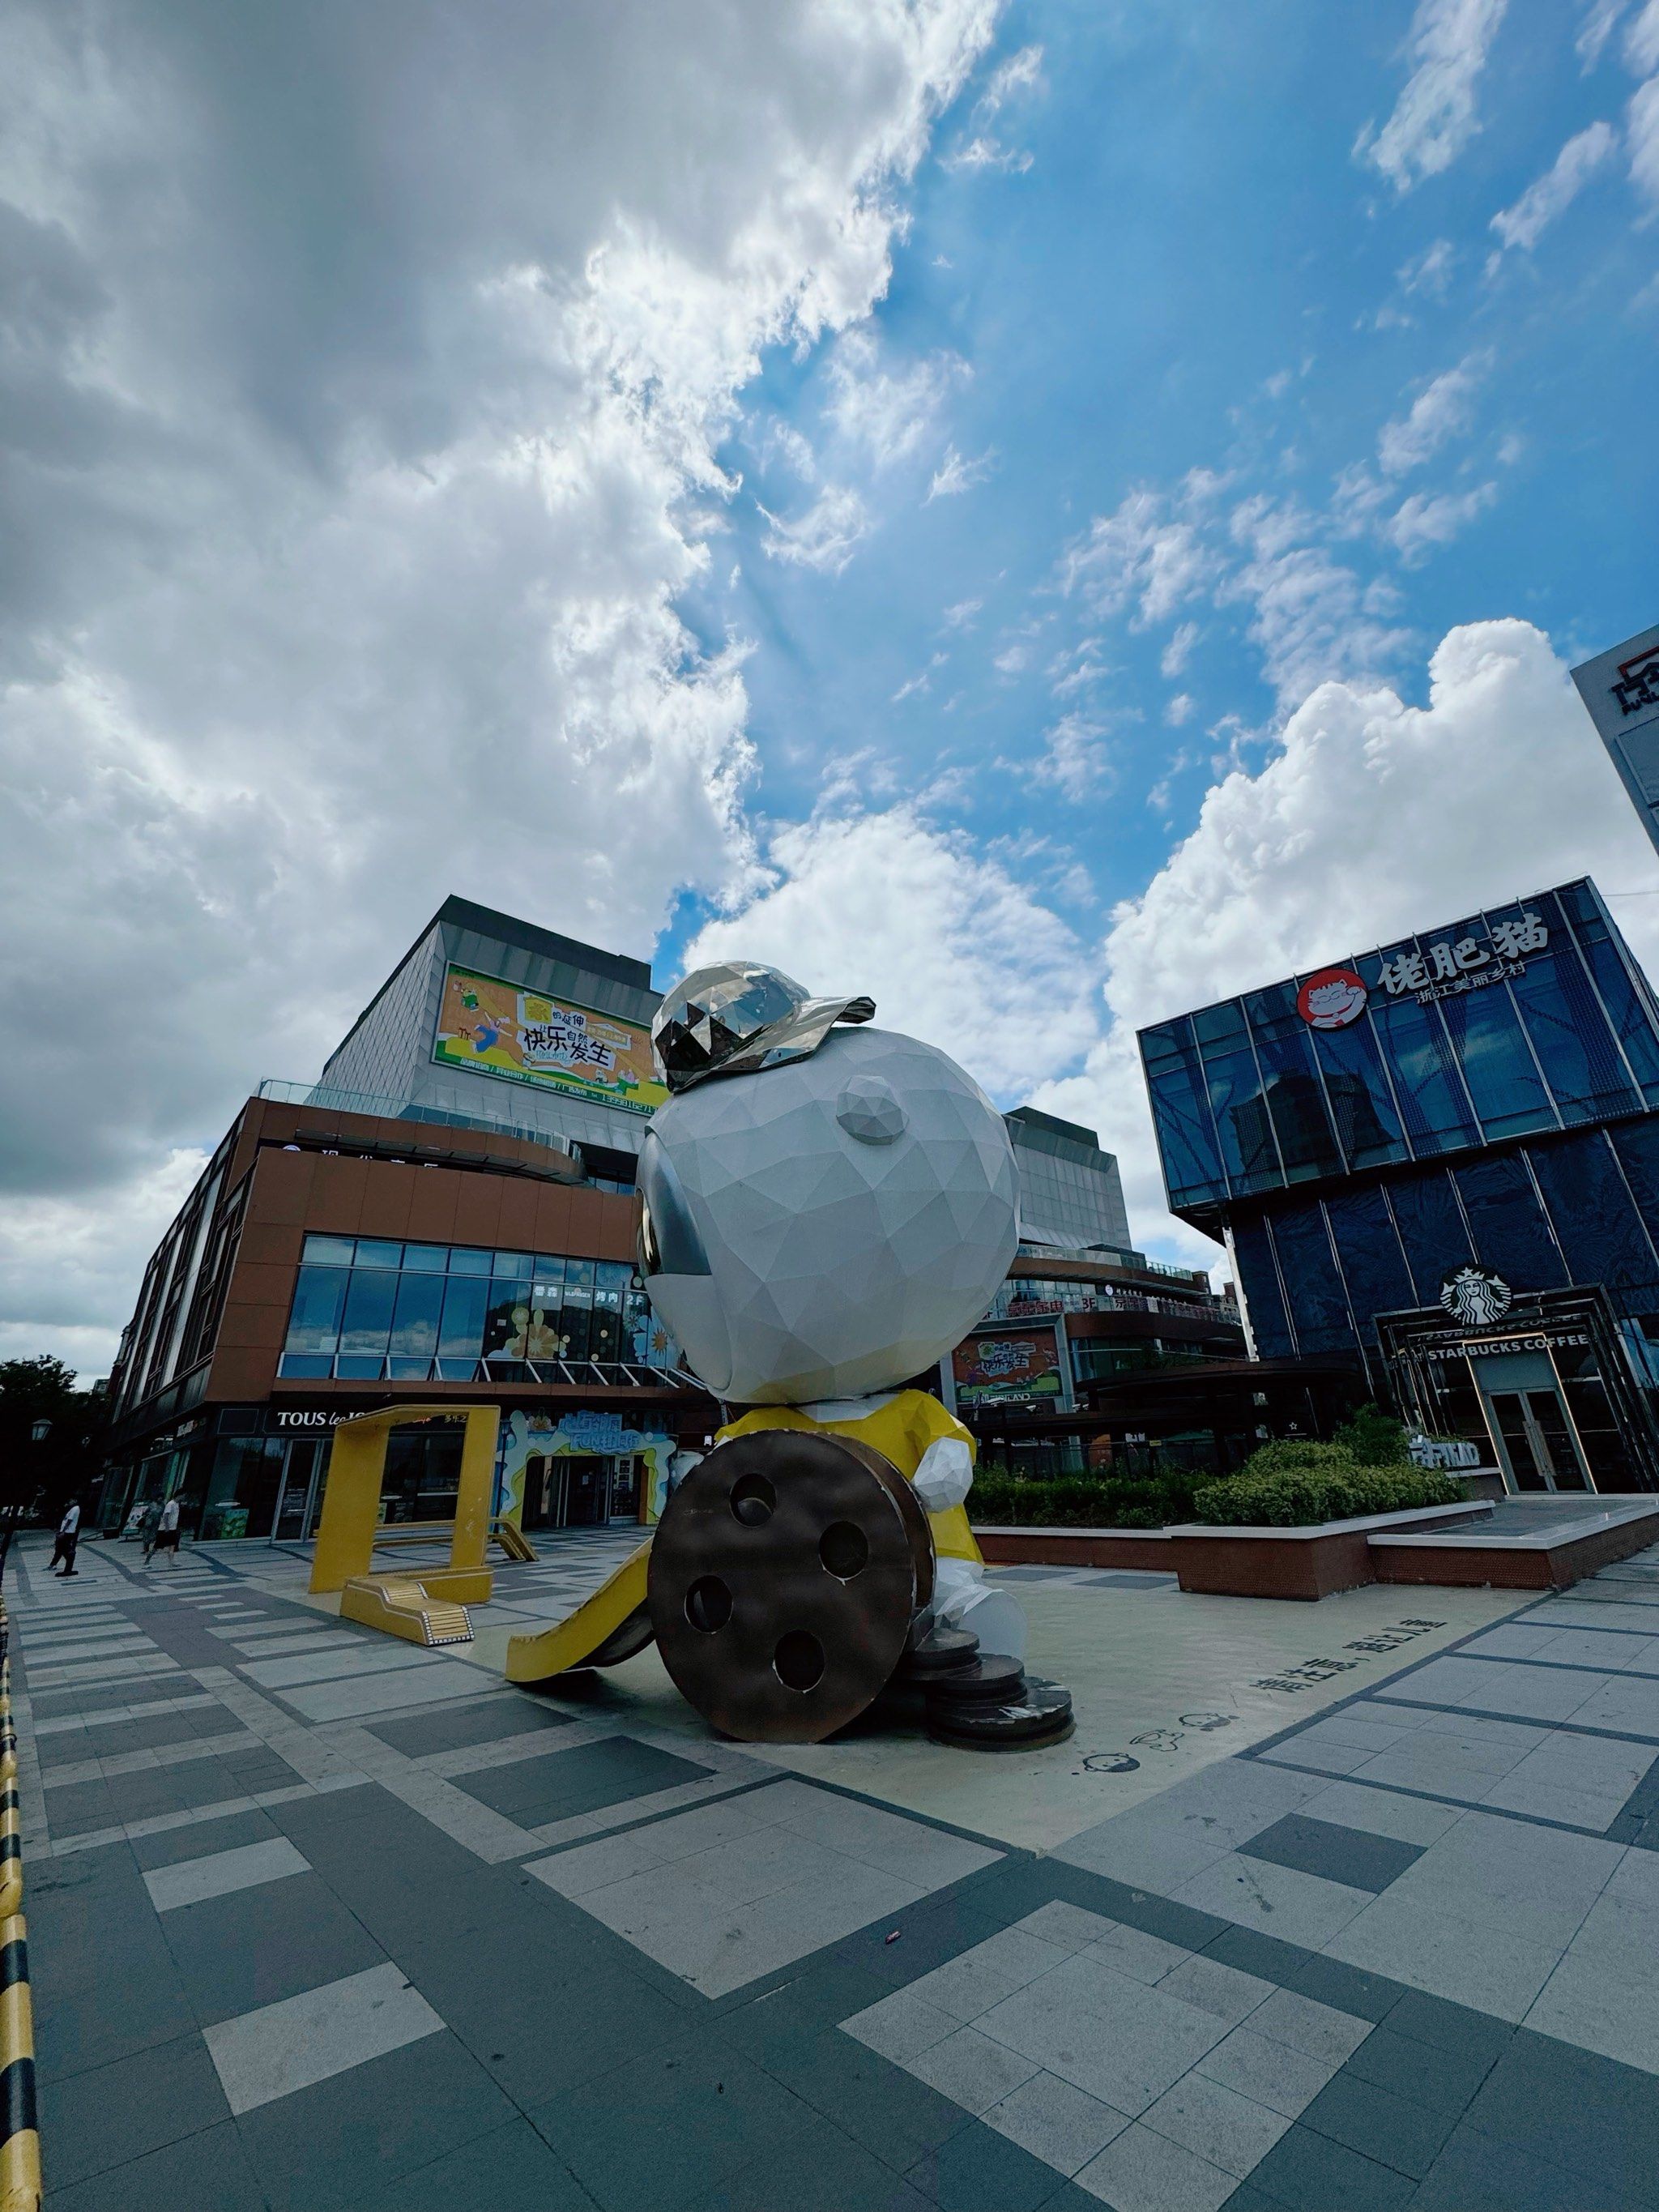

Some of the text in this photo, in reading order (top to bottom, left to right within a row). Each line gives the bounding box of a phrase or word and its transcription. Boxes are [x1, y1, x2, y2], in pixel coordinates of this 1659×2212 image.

[1377, 912, 1549, 995] 佬肥猫
[1414, 960, 1525, 1005] 浙江美丽乡村
[626, 1294, 644, 1305] 2F
[1082, 1298, 1095, 1309] 3F
[1427, 1341, 1521, 1361] STARBUCKS
[1523, 1334, 1589, 1350] COFFEE
[277, 1411, 326, 1425] TOUS
[1249, 1619, 1448, 1693] 请注意，避让儿童
